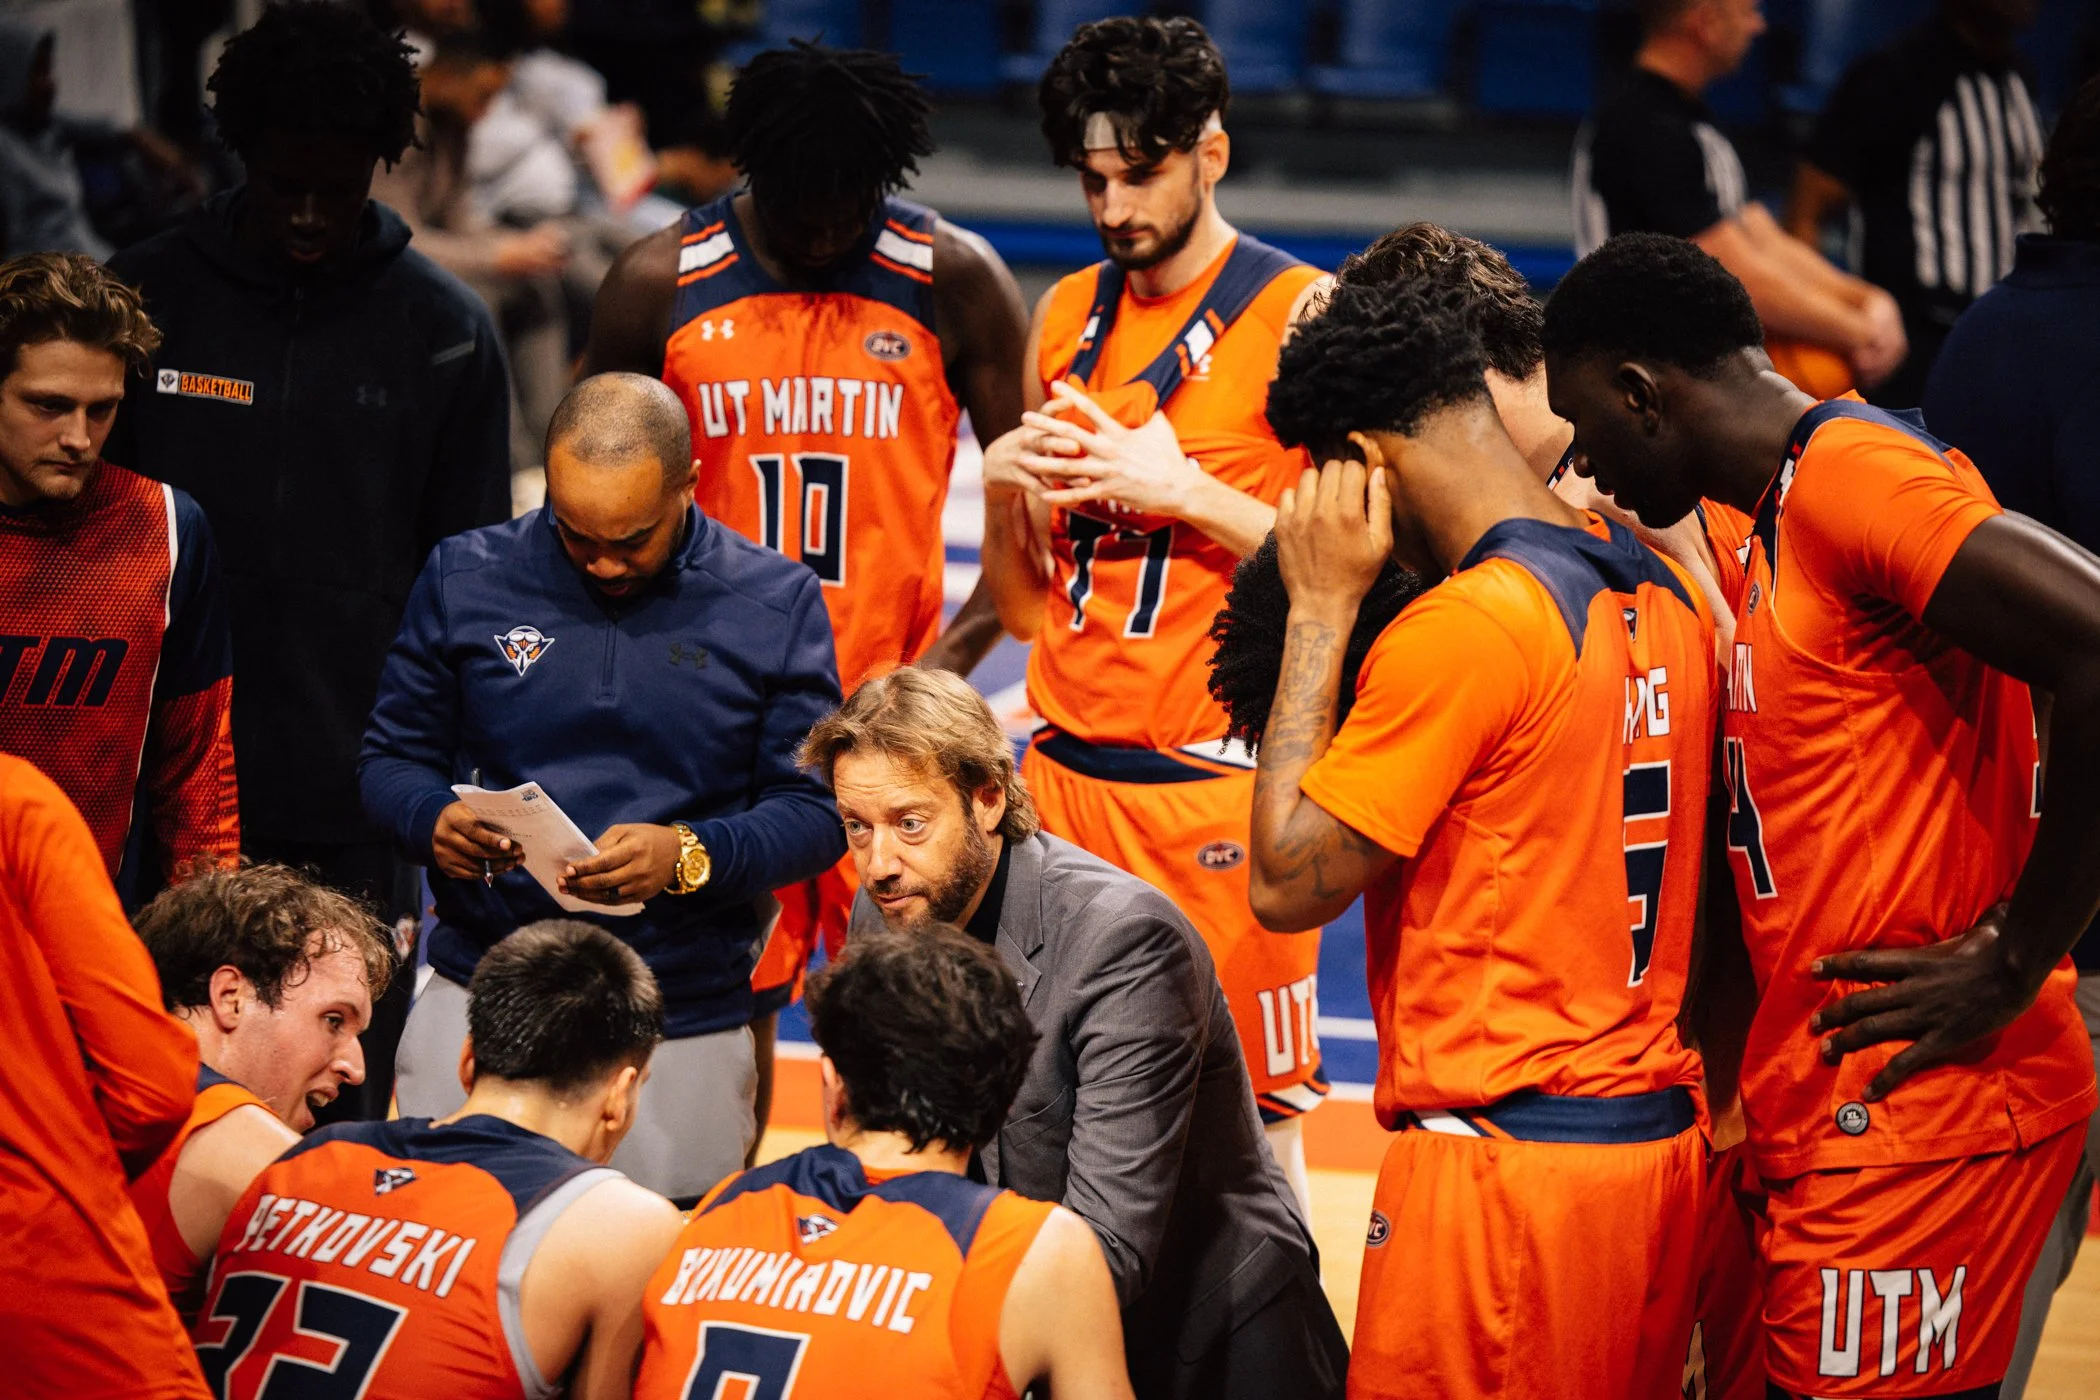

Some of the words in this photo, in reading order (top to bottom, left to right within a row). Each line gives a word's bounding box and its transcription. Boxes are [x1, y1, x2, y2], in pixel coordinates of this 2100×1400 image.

[181, 374, 251, 400] BASKETBALL
[699, 379, 749, 438] UT
[760, 376, 904, 440] MARTIN
[749, 452, 850, 588] 10
[0, 635, 130, 708] TM
[233, 1194, 477, 1298] PETKOVSKI
[1818, 1265, 1967, 1378] UTM
